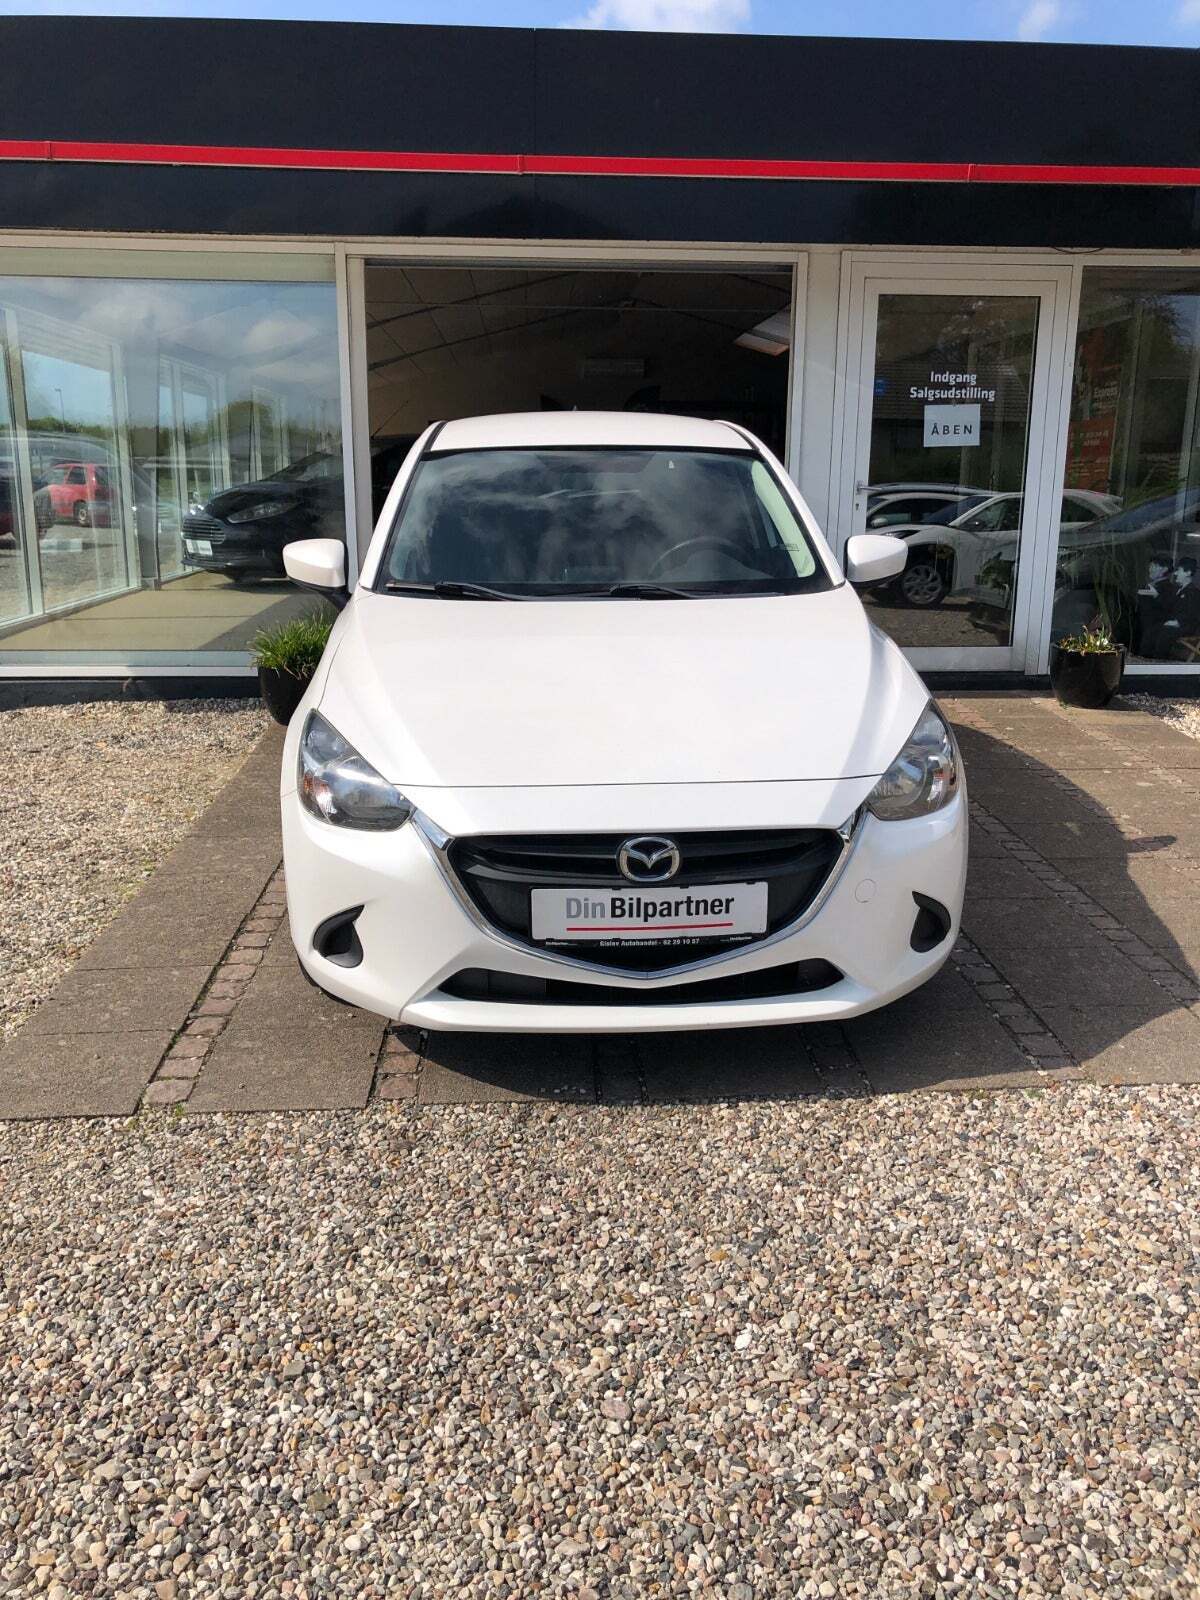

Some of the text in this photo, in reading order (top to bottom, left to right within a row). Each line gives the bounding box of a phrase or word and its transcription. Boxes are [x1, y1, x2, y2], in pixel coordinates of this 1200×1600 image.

[930, 371, 977, 385] Indgang
[909, 386, 996, 402] Salgsudstilling
[931, 422, 973, 435] ÅBEN
[566, 895, 735, 923] Din Bilpartner
